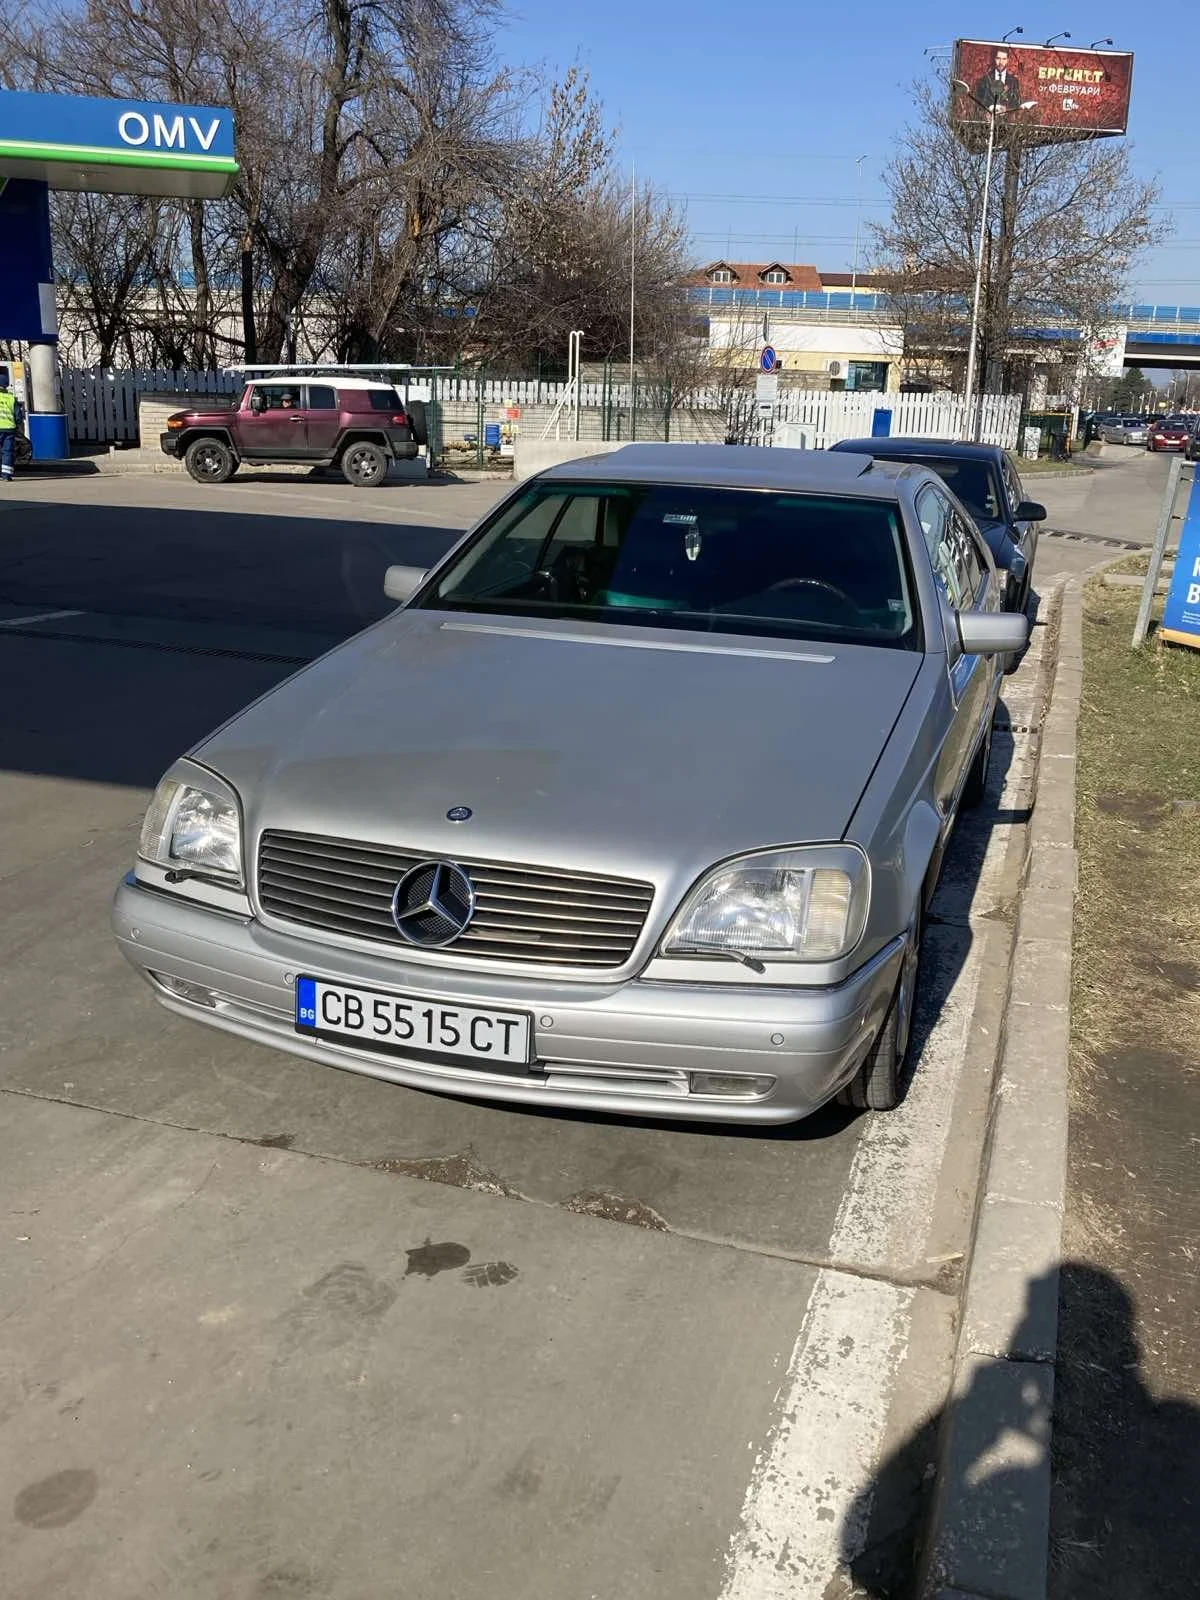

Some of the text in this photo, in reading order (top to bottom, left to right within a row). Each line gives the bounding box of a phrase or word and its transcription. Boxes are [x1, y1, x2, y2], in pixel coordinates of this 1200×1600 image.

[1049, 83, 1100, 96] ФЕВРУАРИ
[118, 112, 220, 150] OMV
[300, 1007, 315, 1020] BG
[322, 990, 519, 1055] CB 5515 CT
